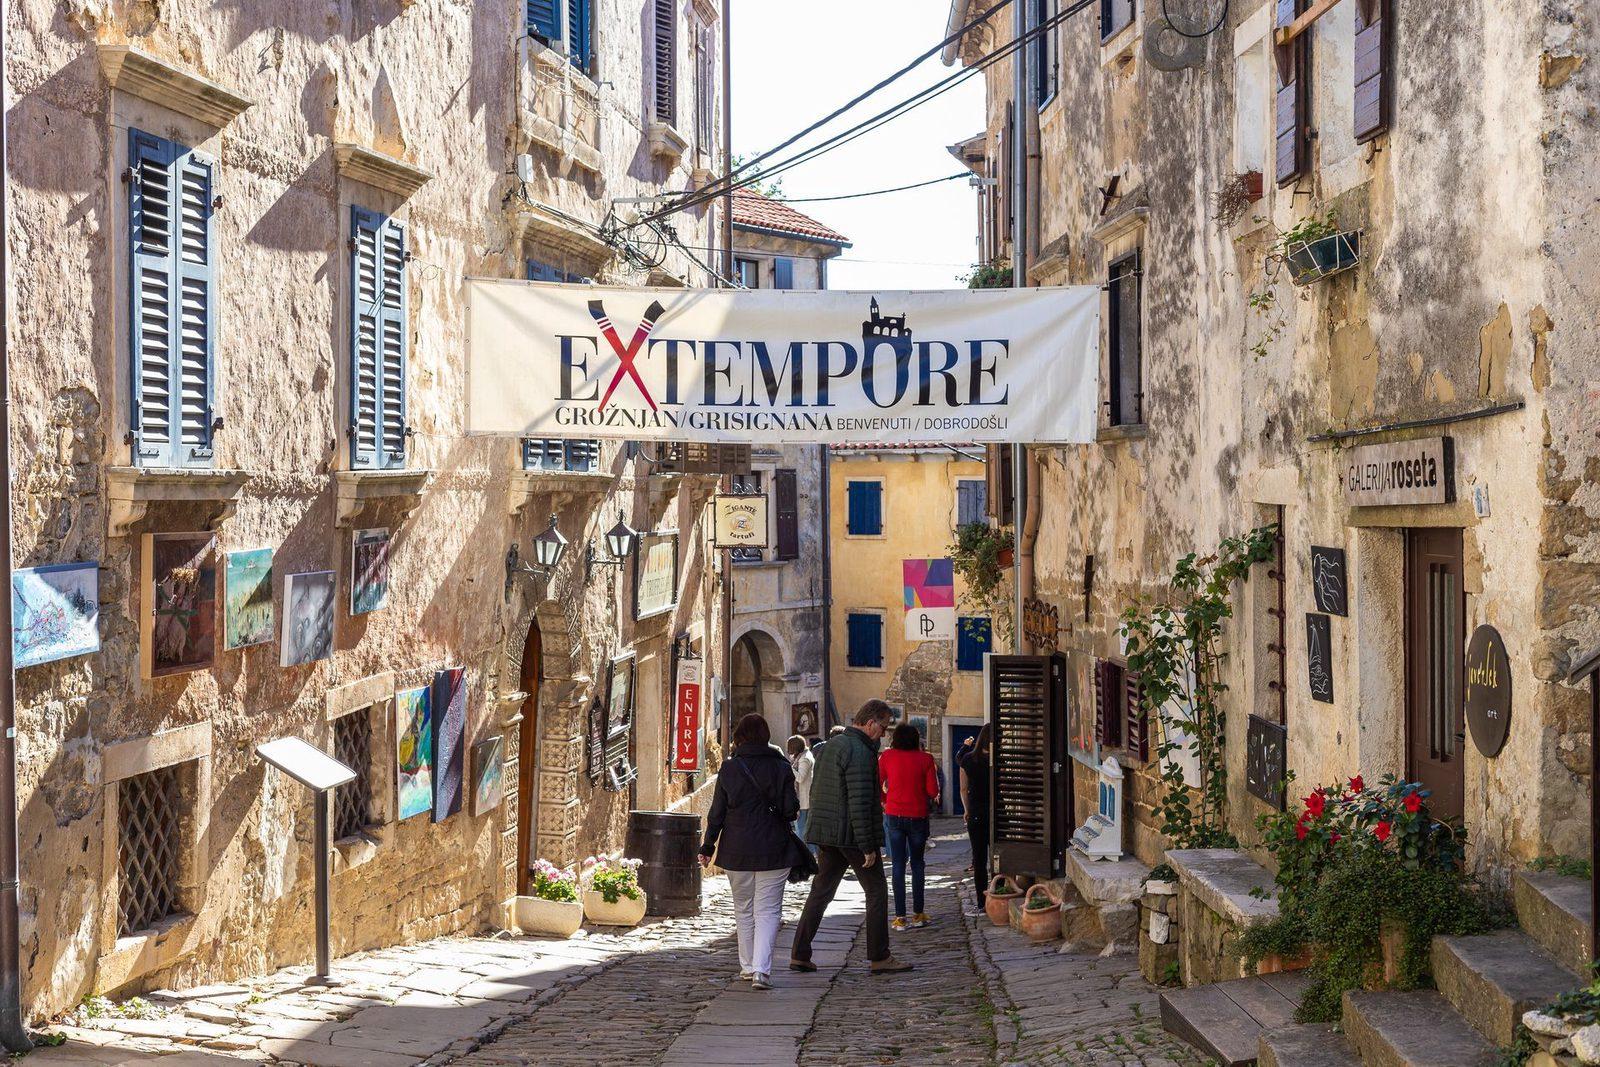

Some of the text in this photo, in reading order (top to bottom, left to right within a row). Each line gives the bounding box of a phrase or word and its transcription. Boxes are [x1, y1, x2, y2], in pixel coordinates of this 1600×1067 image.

[554, 297, 1009, 413] EXTEMPORE
[837, 416, 911, 431] BENVENUTI
[924, 414, 1008, 430] DOBRODOŠLI
[684, 689, 693, 753] ENTRY
